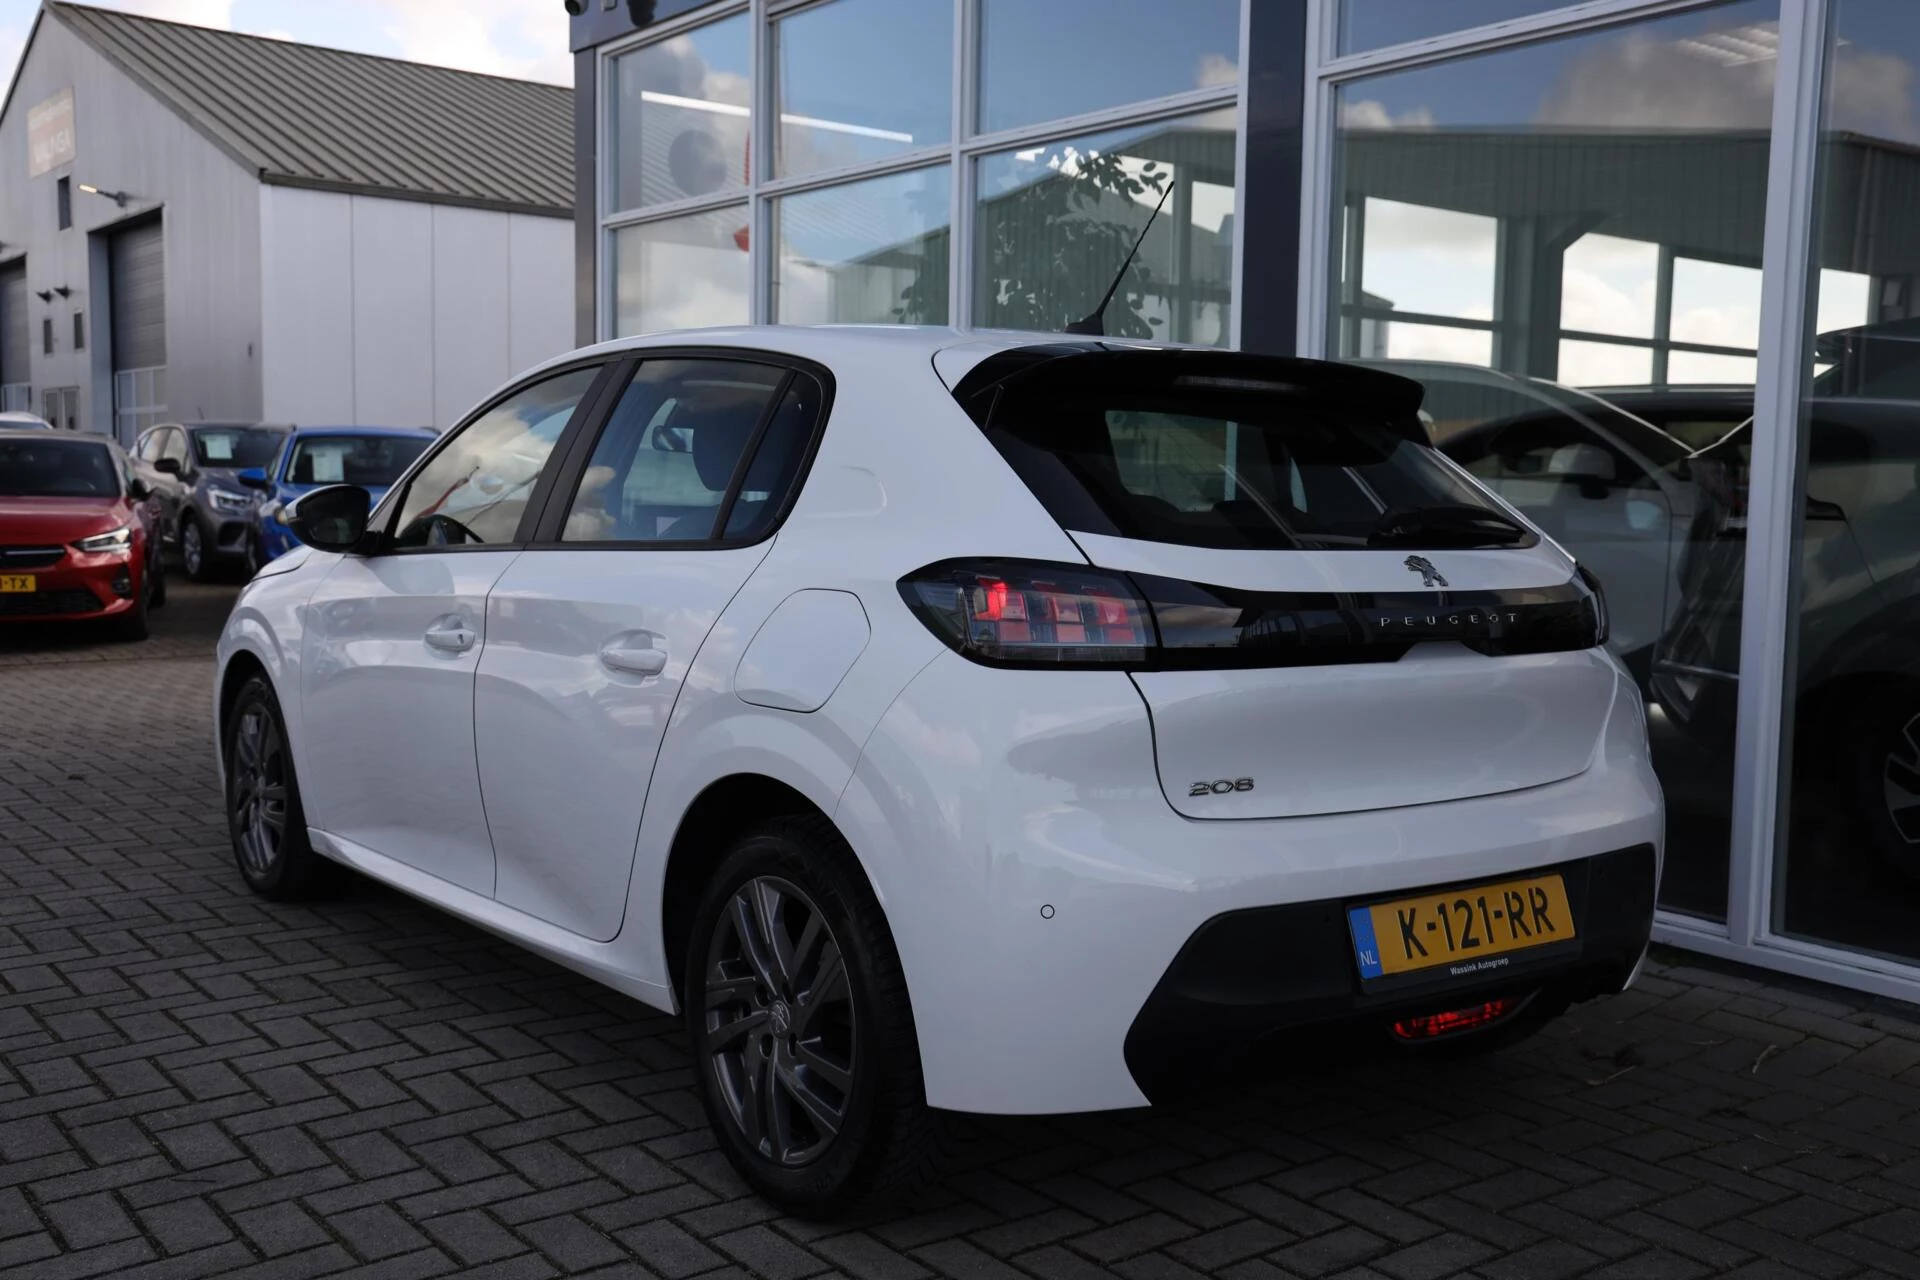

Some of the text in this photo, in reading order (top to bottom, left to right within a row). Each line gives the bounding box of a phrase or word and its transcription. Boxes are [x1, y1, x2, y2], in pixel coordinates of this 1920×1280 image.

[0, 577, 29, 589] -TX
[1380, 613, 1517, 627] PEUGEOT
[1188, 777, 1254, 797] 208
[1397, 887, 1556, 960] K-121-RR
[1360, 949, 1378, 966] NL
[1450, 957, 1509, 976] Wassink Autogroep
